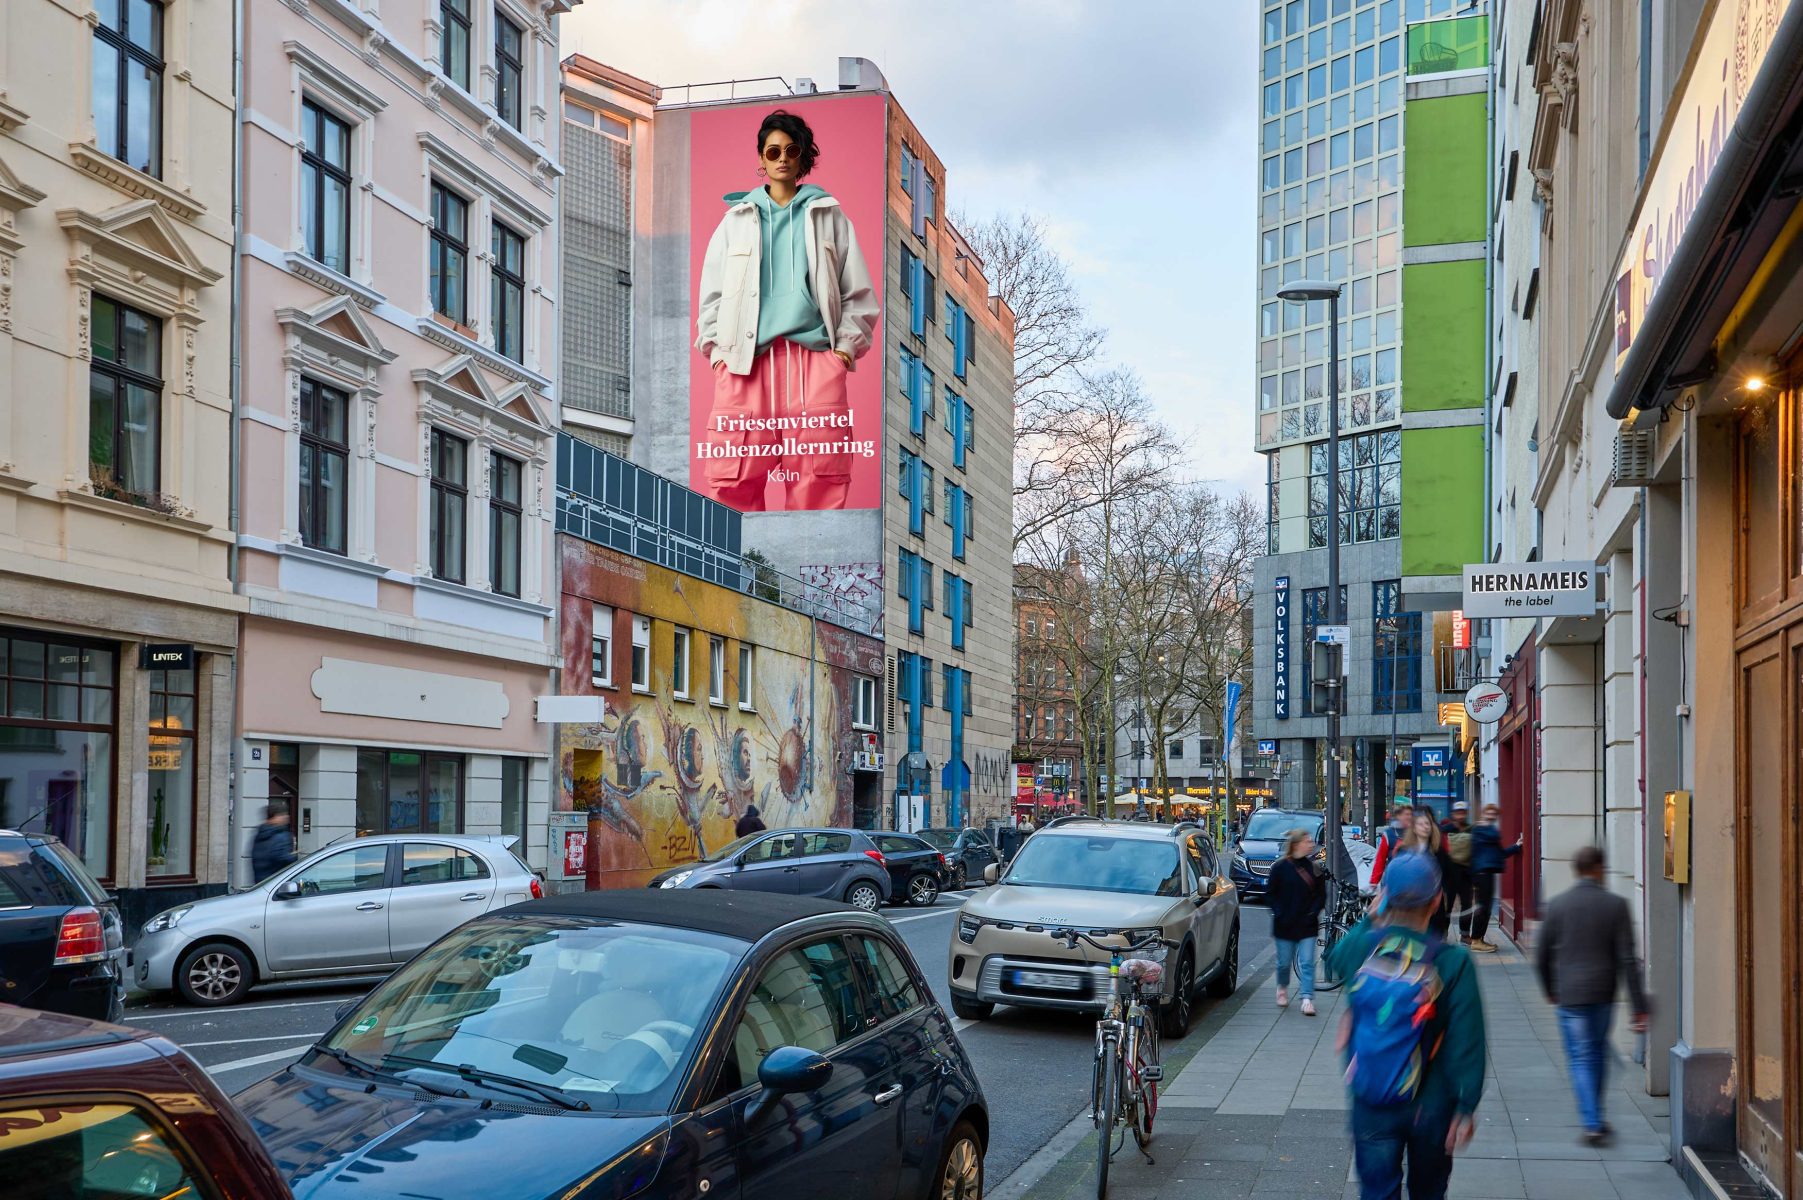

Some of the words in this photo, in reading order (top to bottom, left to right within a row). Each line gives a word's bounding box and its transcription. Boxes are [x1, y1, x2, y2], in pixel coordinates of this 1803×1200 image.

[715, 409, 854, 432] Friesenviertel
[695, 436, 875, 459] Hohenzollernring
[766, 469, 800, 482] Köln
[1471, 571, 1588, 593] HERNAMEIS
[1505, 596, 1522, 606] the
[1526, 595, 1554, 606] label
[153, 653, 182, 661] LINTEX
[1276, 592, 1286, 714] VOLKSBANK
